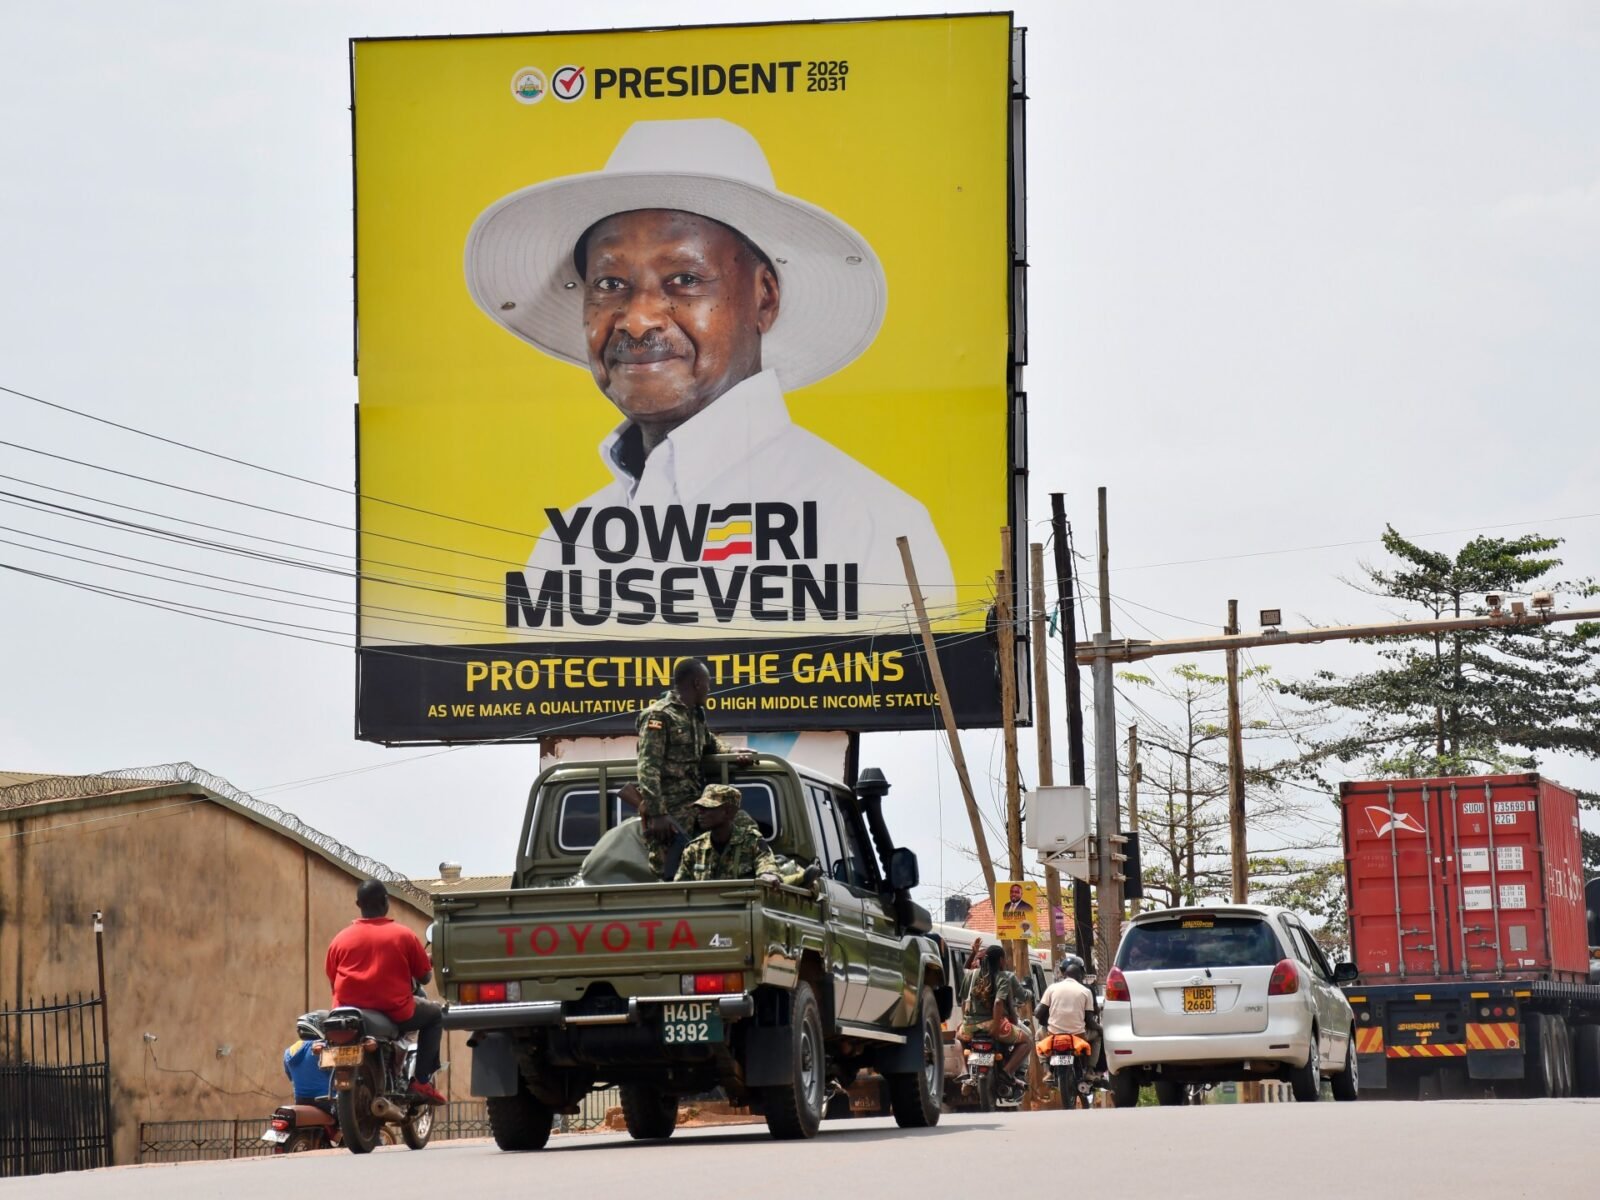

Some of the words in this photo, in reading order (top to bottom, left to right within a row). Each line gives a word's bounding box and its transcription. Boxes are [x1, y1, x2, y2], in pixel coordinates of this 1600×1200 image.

[807, 60, 849, 77] 2026
[594, 61, 802, 100] PRESIDENT
[806, 76, 847, 92] 2031
[544, 501, 818, 565] YOWERI
[505, 563, 859, 628] MUSEVENI
[707, 653, 780, 685] THE
[792, 651, 905, 684] GAINS
[427, 704, 447, 718] AS
[451, 703, 475, 717] WE
[479, 702, 522, 717] MAKE
[526, 702, 536, 715] A
[540, 699, 635, 715] QUALITATIVE
[721, 697, 757, 710] HIGH
[761, 695, 818, 709] MIDDLE
[823, 694, 881, 708] INCOME
[885, 692, 942, 707] STATUS
[1495, 801, 1525, 812] 735699
[497, 918, 699, 957] TOYOTA
[1192, 988, 1212, 1000] UBC
[663, 1002, 712, 1022] H4DF
[1187, 1000, 1212, 1011] 266D
[664, 1023, 709, 1043] 3392
